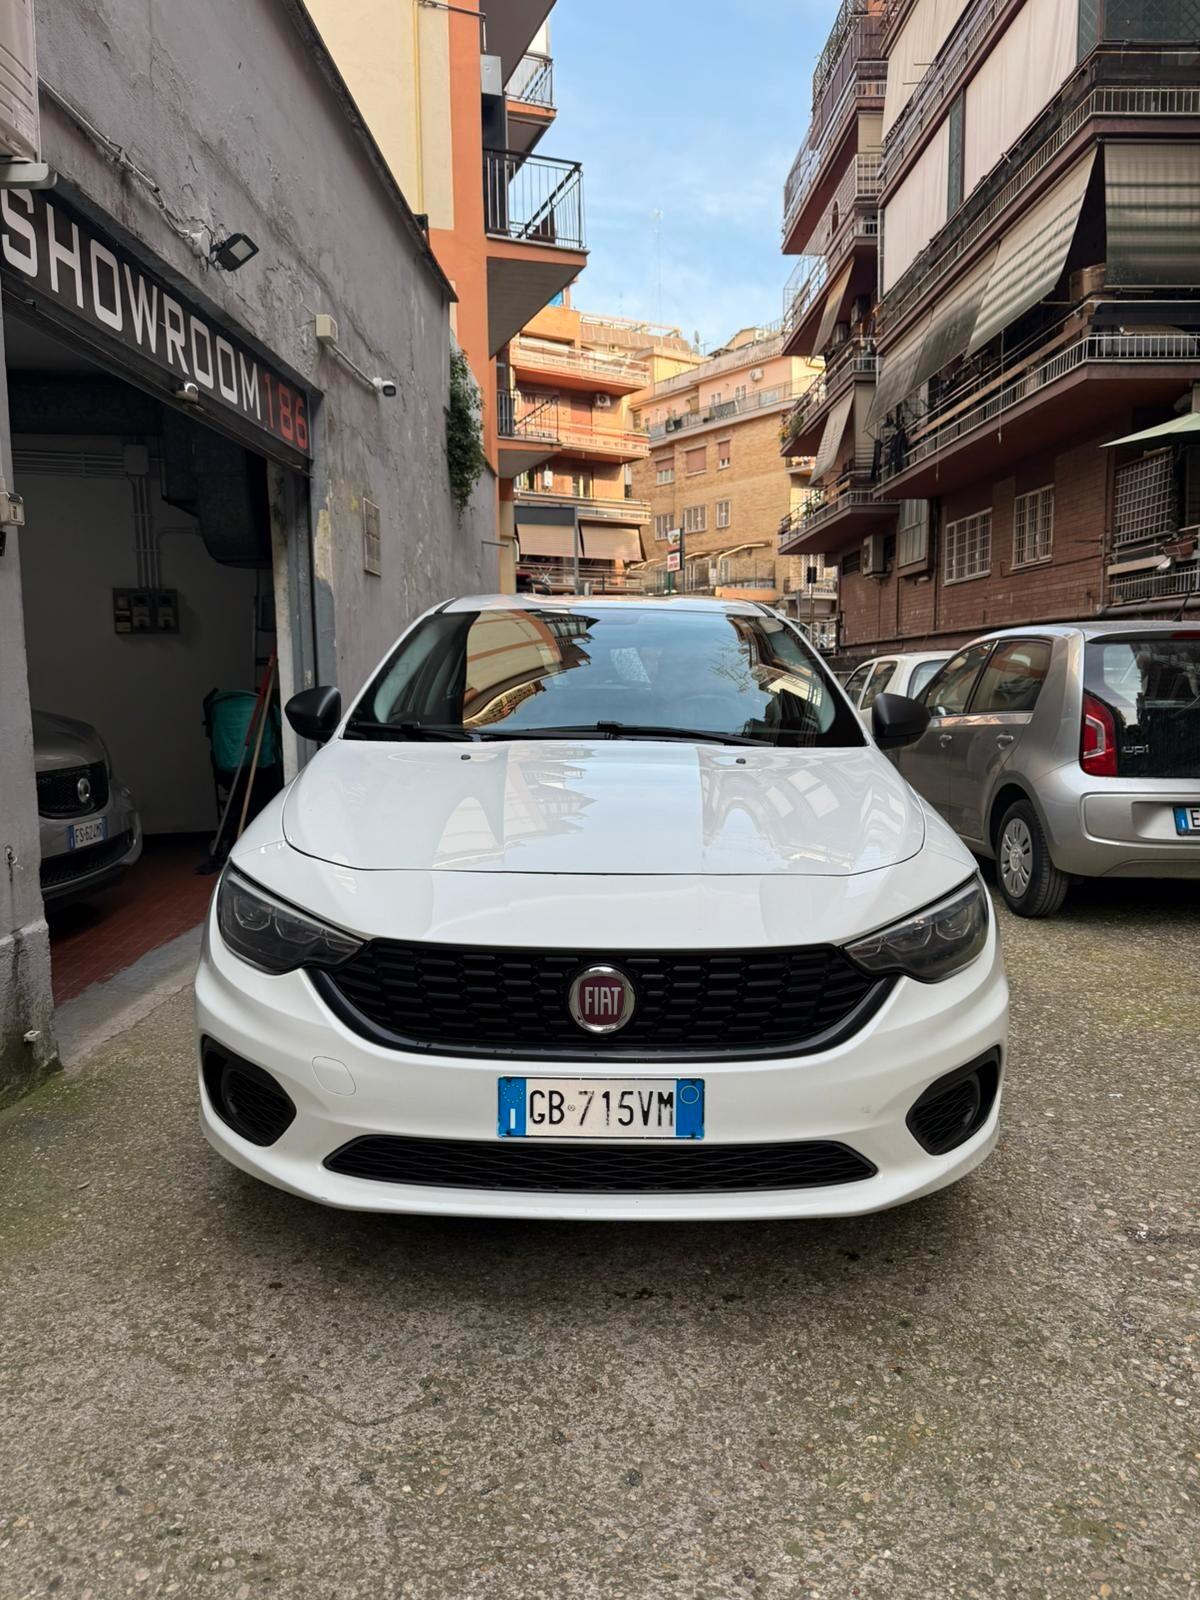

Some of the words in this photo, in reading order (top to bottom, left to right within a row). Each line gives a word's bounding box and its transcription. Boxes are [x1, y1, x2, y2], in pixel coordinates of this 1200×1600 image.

[1, 188, 262, 420] SHOWROOM
[264, 373, 308, 450] 186
[584, 986, 621, 1015] FIAT
